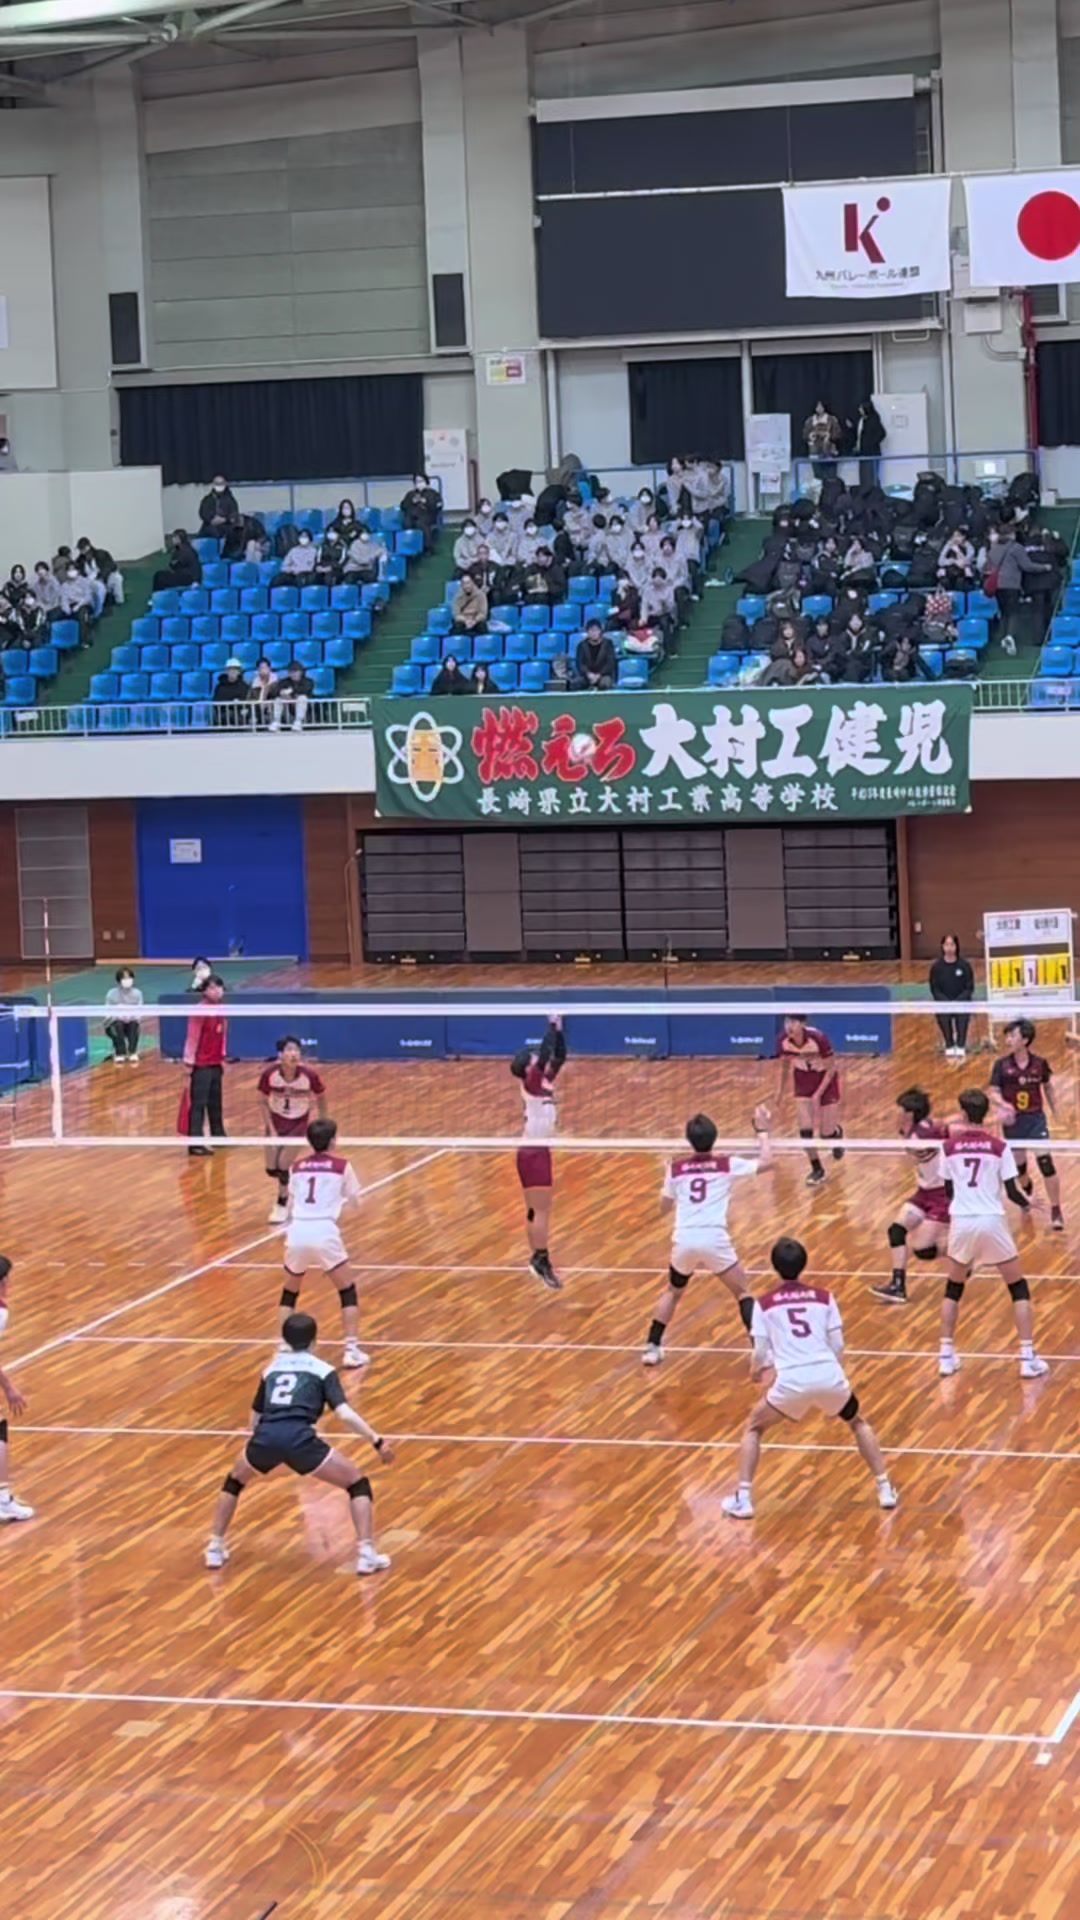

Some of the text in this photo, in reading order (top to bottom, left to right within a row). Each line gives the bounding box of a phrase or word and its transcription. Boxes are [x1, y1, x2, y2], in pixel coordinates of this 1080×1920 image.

[477, 783, 838, 815] 長崎県立大村工業高等学校
[1017, 1091, 1029, 1111] 9
[964, 1158, 980, 1187] 7
[305, 1176, 316, 1204] 1
[689, 1177, 706, 1204] 9
[787, 1307, 812, 1338] 5
[270, 1373, 298, 1405] 2
